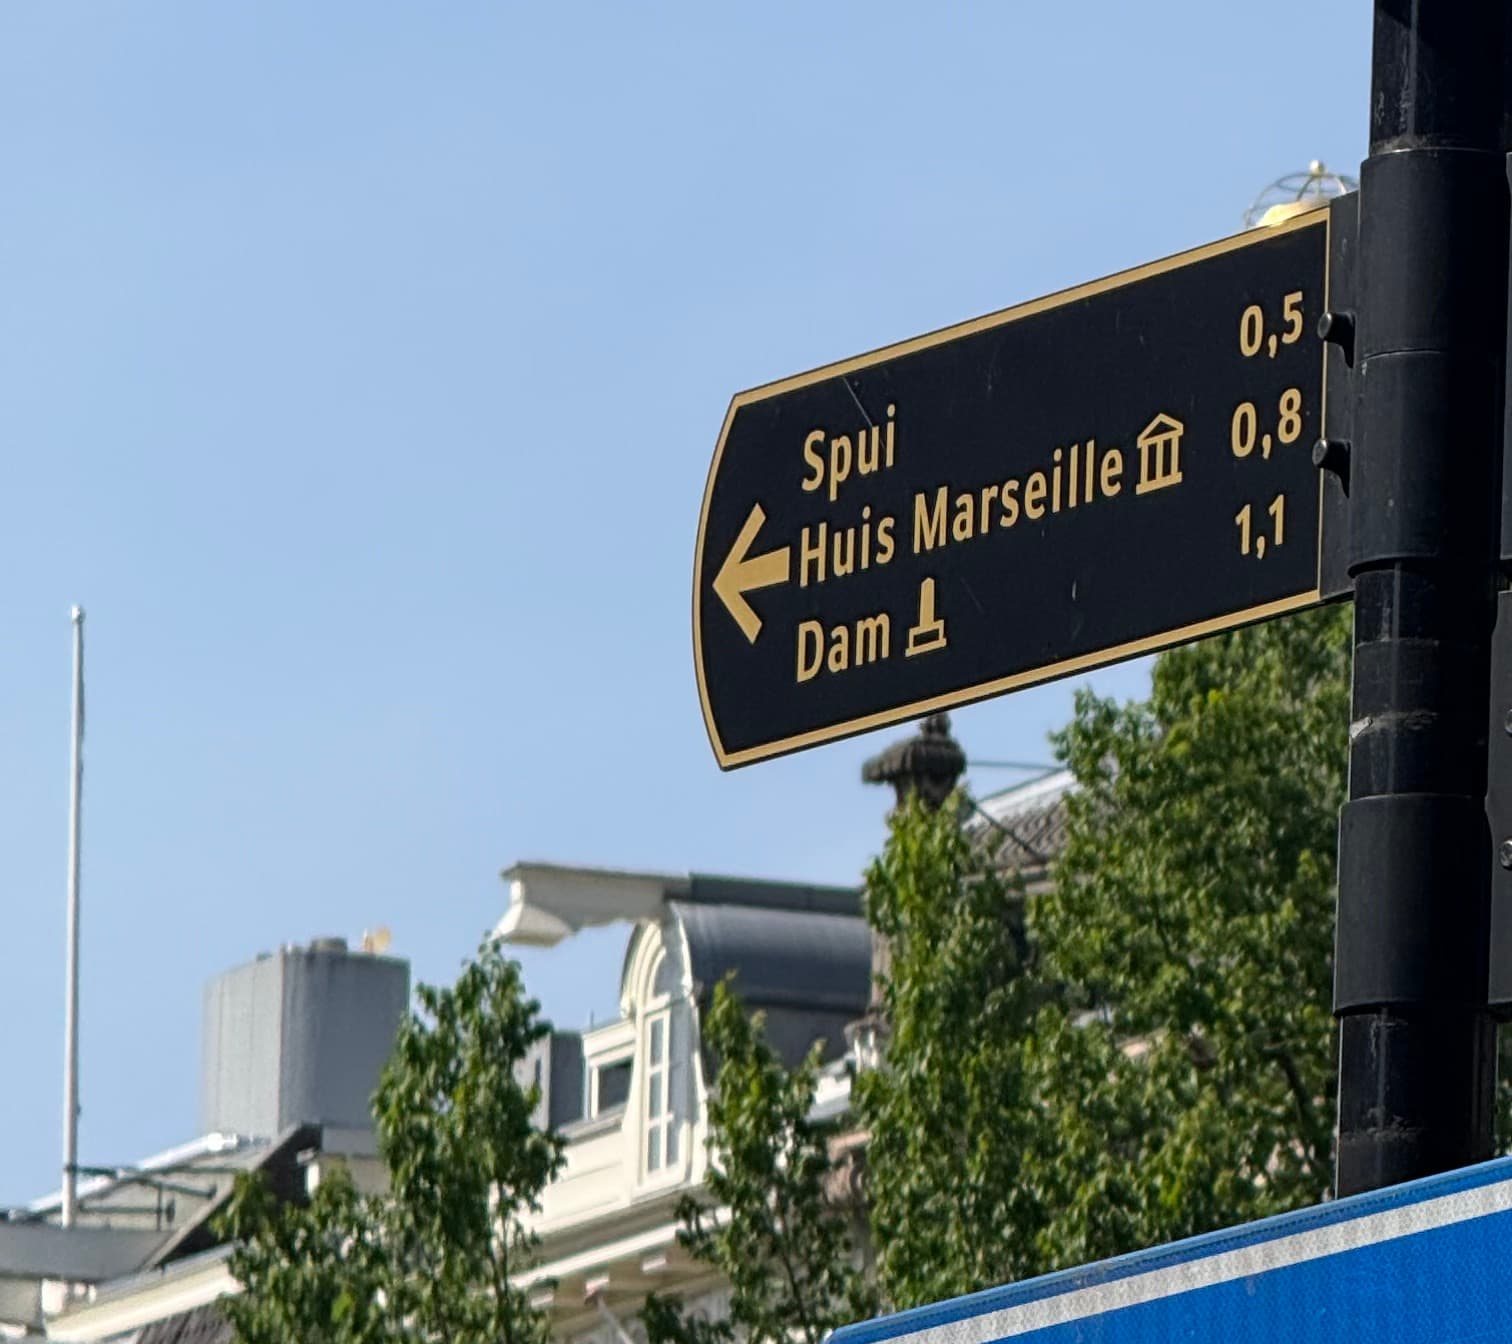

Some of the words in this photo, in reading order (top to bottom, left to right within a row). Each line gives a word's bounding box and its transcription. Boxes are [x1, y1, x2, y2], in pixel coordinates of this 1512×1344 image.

[799, 506, 896, 588] Huis
[912, 439, 1124, 554] Marseille
[1231, 388, 1302, 459] 0,8
[801, 404, 896, 502] Spui
[1240, 291, 1304, 359] 0,5
[796, 613, 890, 683] Dam
[1234, 494, 1284, 560] 1,1
